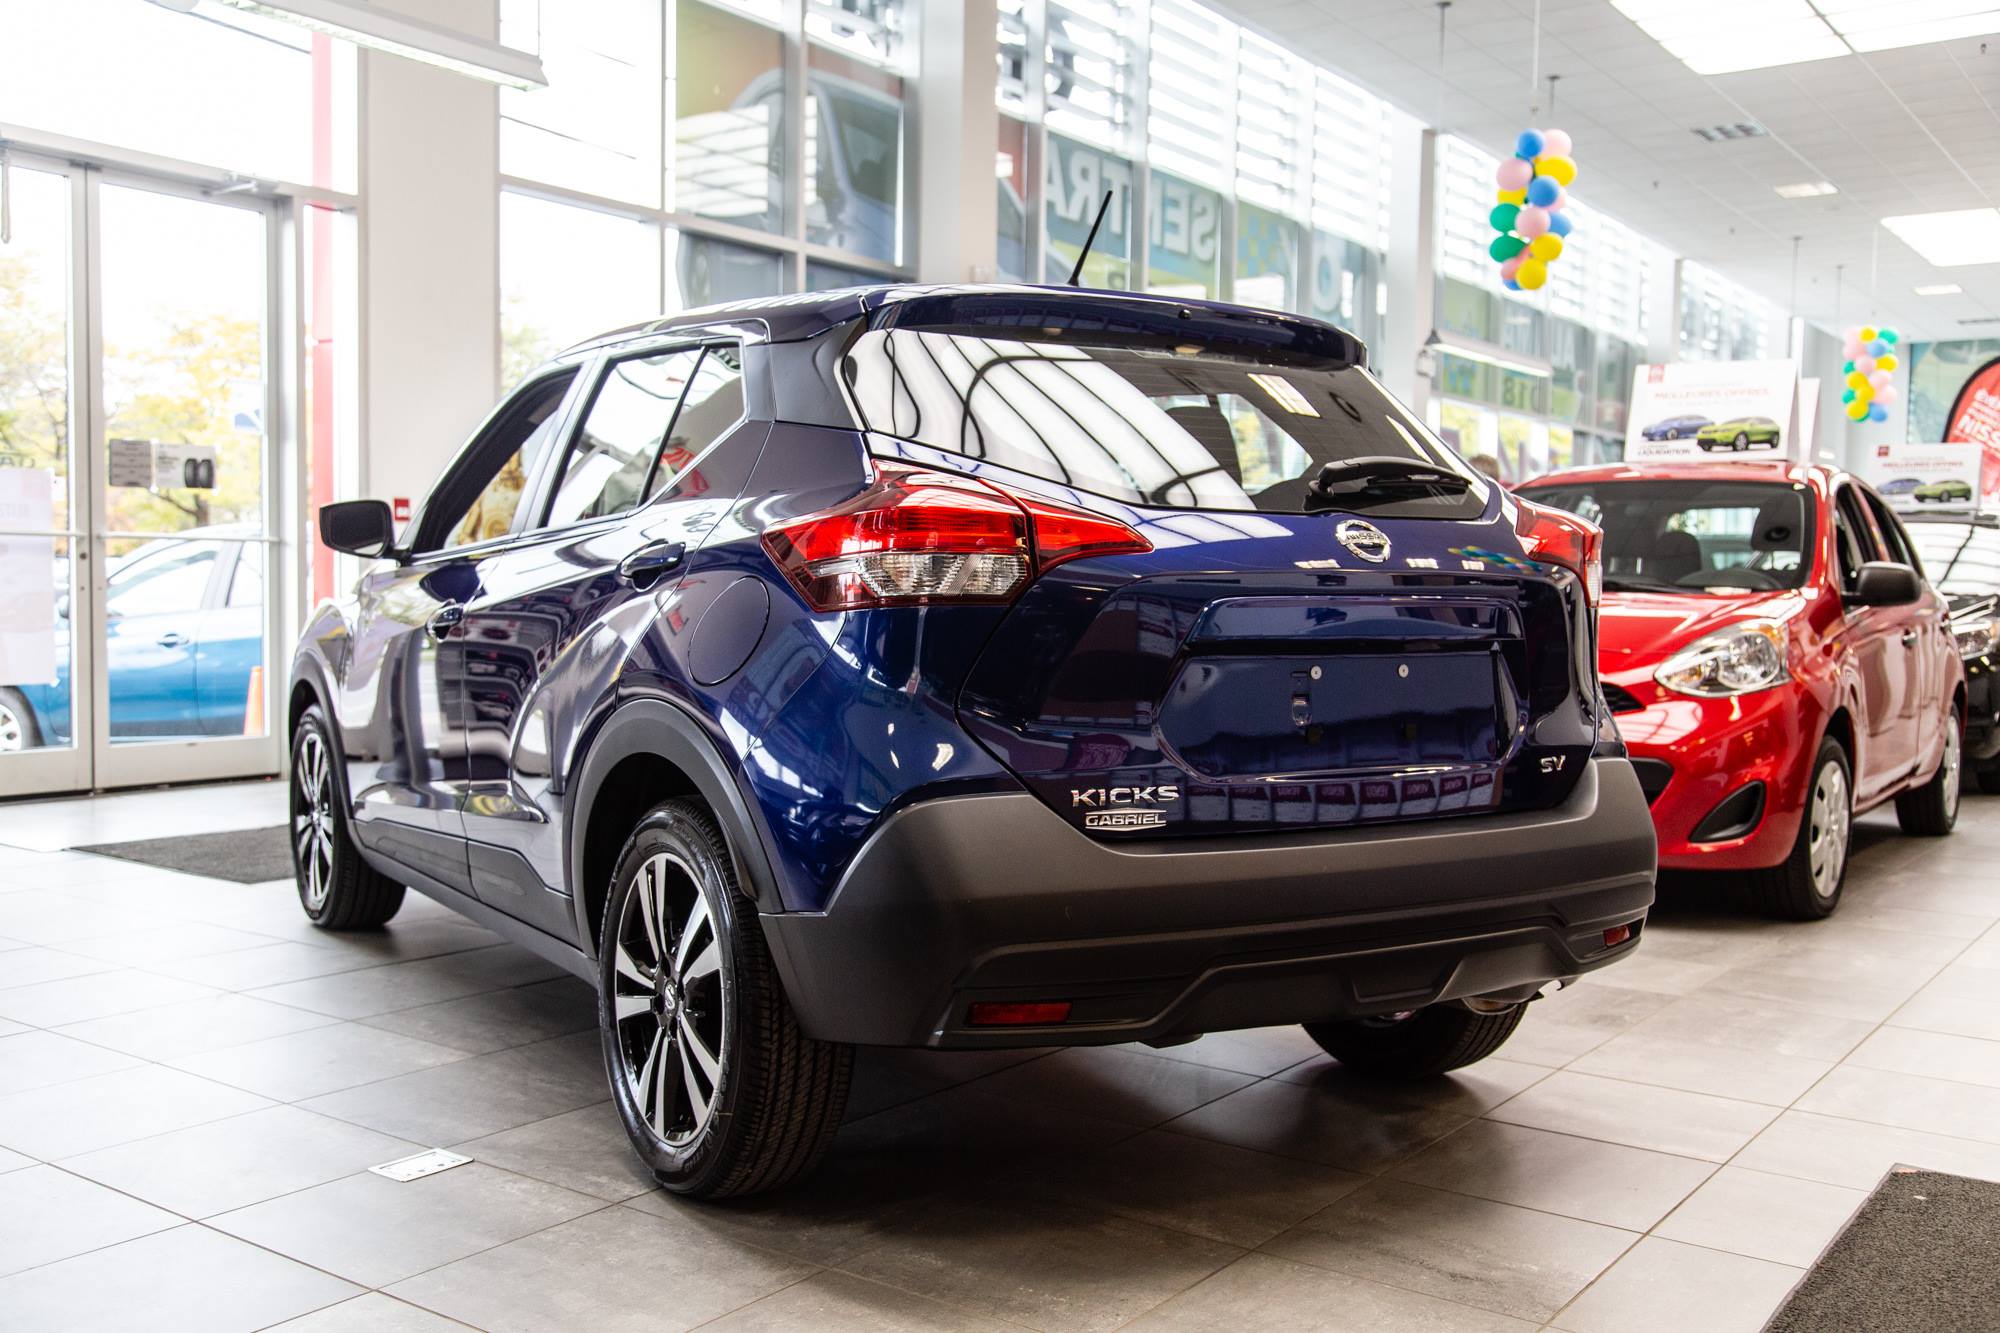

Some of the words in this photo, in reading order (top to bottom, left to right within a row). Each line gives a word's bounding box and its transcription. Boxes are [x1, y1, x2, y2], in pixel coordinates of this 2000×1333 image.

[1540, 754, 1566, 773] SV
[1070, 785, 1180, 808] KICKS
[1085, 813, 1167, 826] GABRIEL
